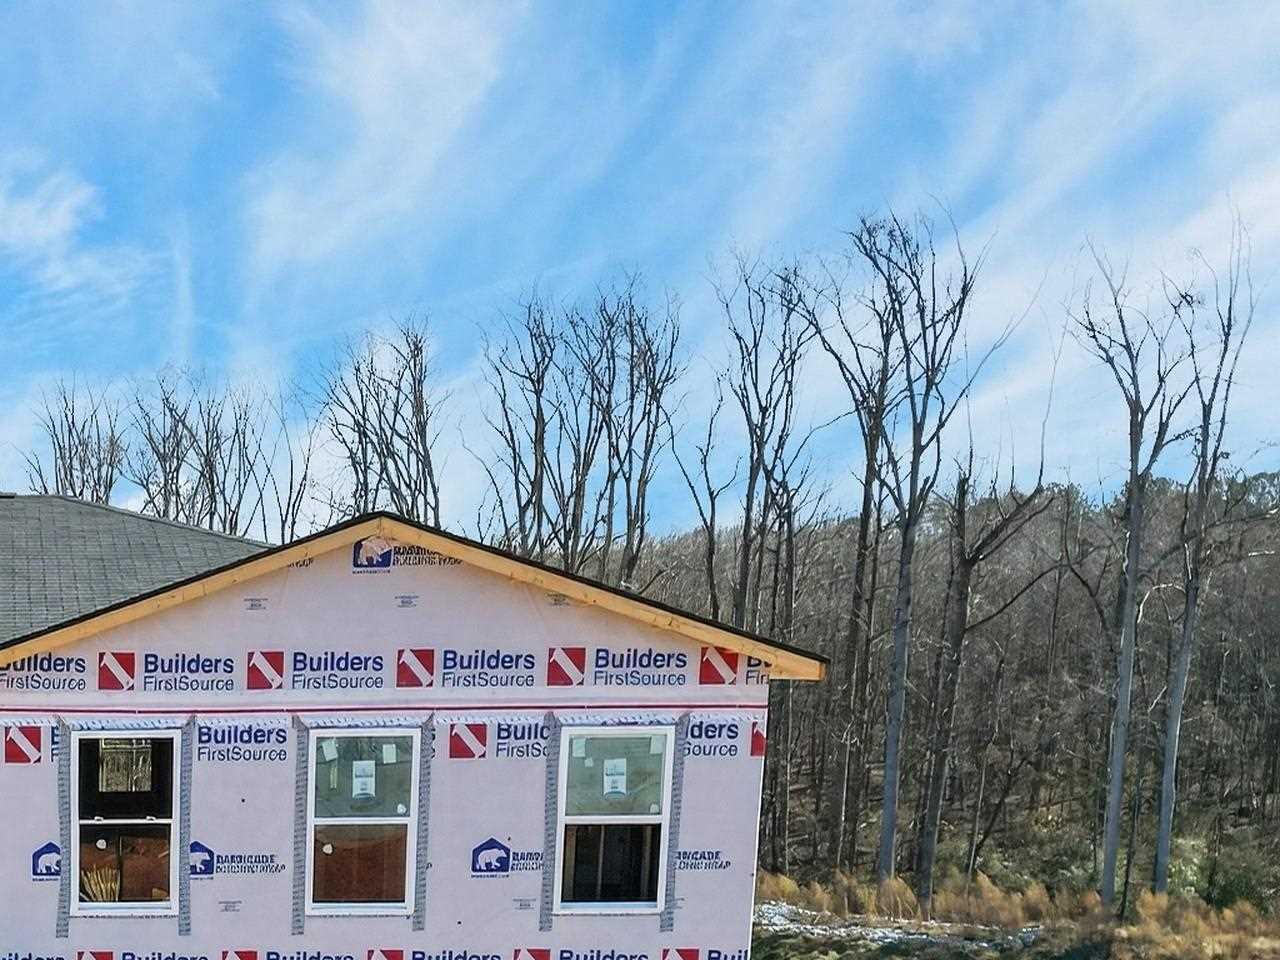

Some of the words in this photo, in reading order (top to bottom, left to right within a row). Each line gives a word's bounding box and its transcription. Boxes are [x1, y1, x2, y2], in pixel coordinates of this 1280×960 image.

[144, 653, 234, 673] Builders
[292, 652, 384, 672] Builders
[442, 651, 535, 671] Builders
[594, 649, 688, 669] Builders
[143, 674, 234, 690] FirstSource
[292, 673, 384, 689] FirstSource
[441, 671, 535, 689] FirstSource
[594, 670, 687, 687] FirstSource
[197, 726, 288, 747] Builders
[197, 747, 288, 761] FirstSource
